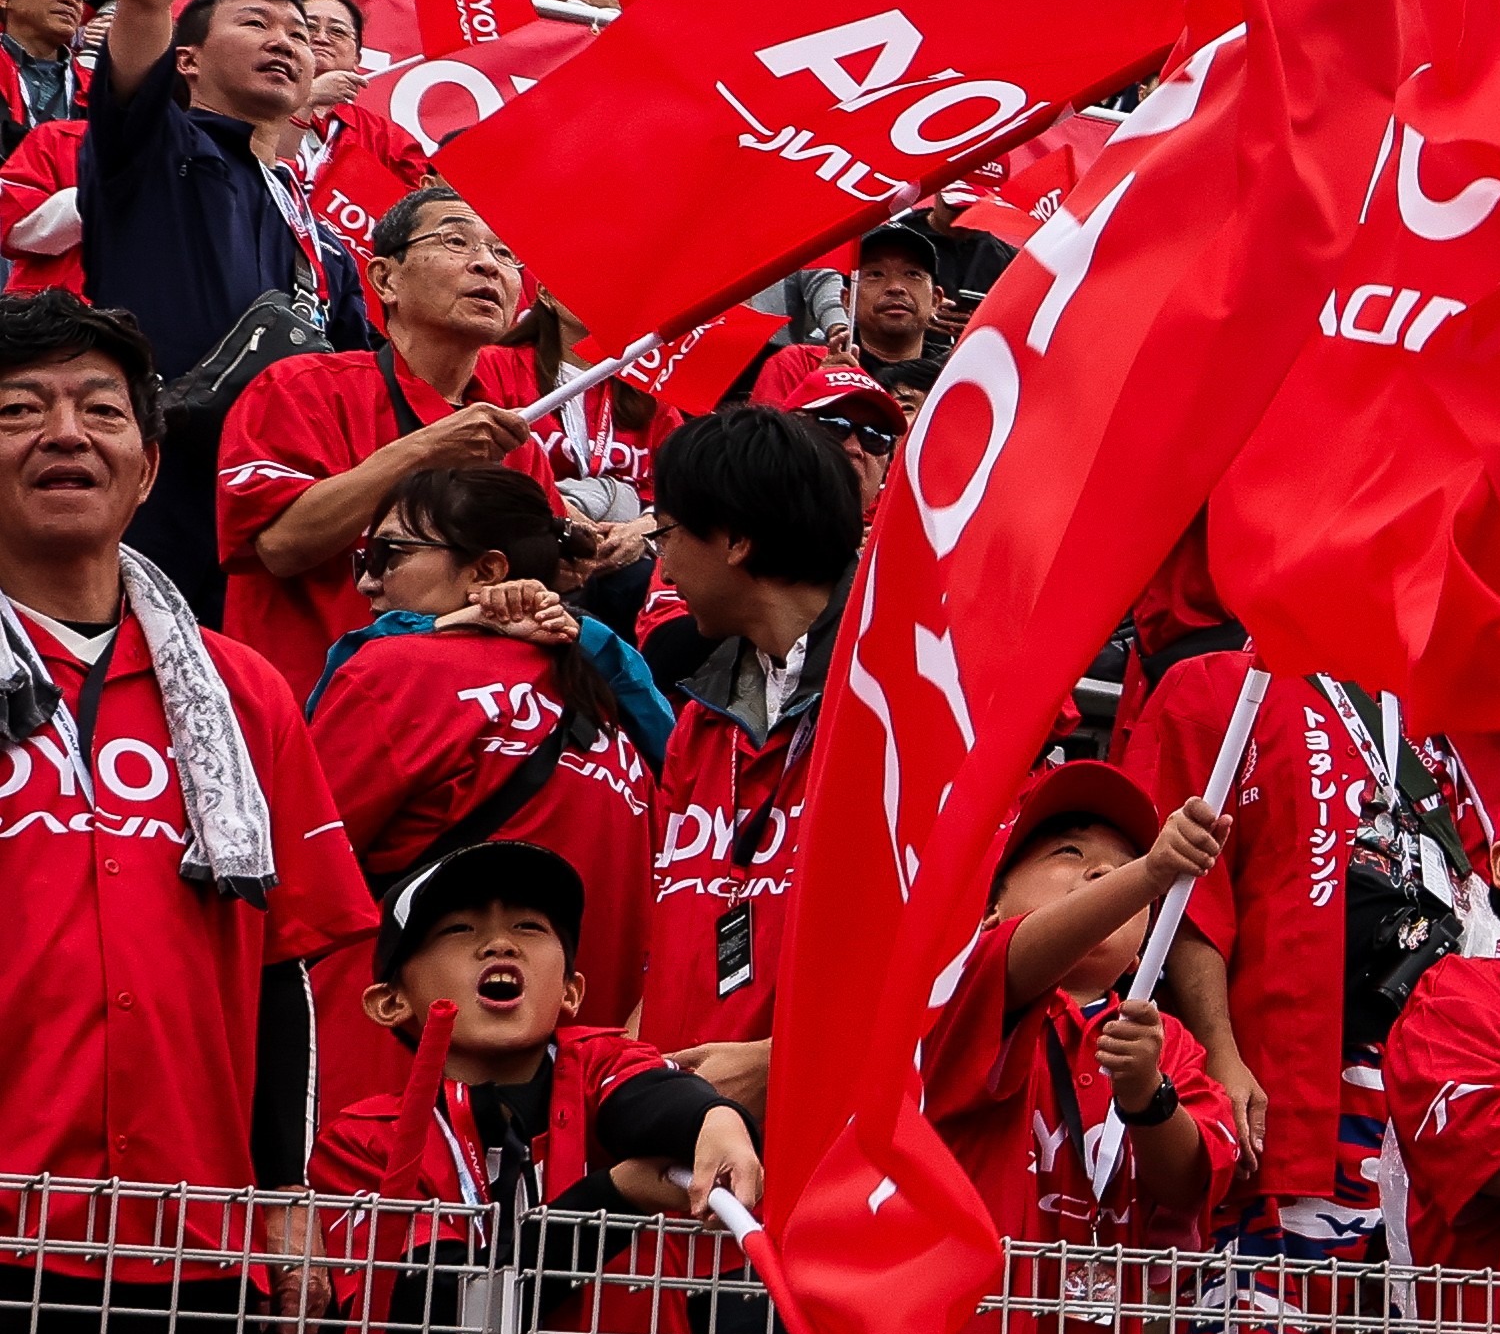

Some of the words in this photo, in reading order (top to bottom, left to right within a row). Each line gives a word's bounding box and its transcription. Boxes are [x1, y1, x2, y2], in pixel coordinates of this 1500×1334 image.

[1303, 705, 1338, 908] トヨタレーシング
